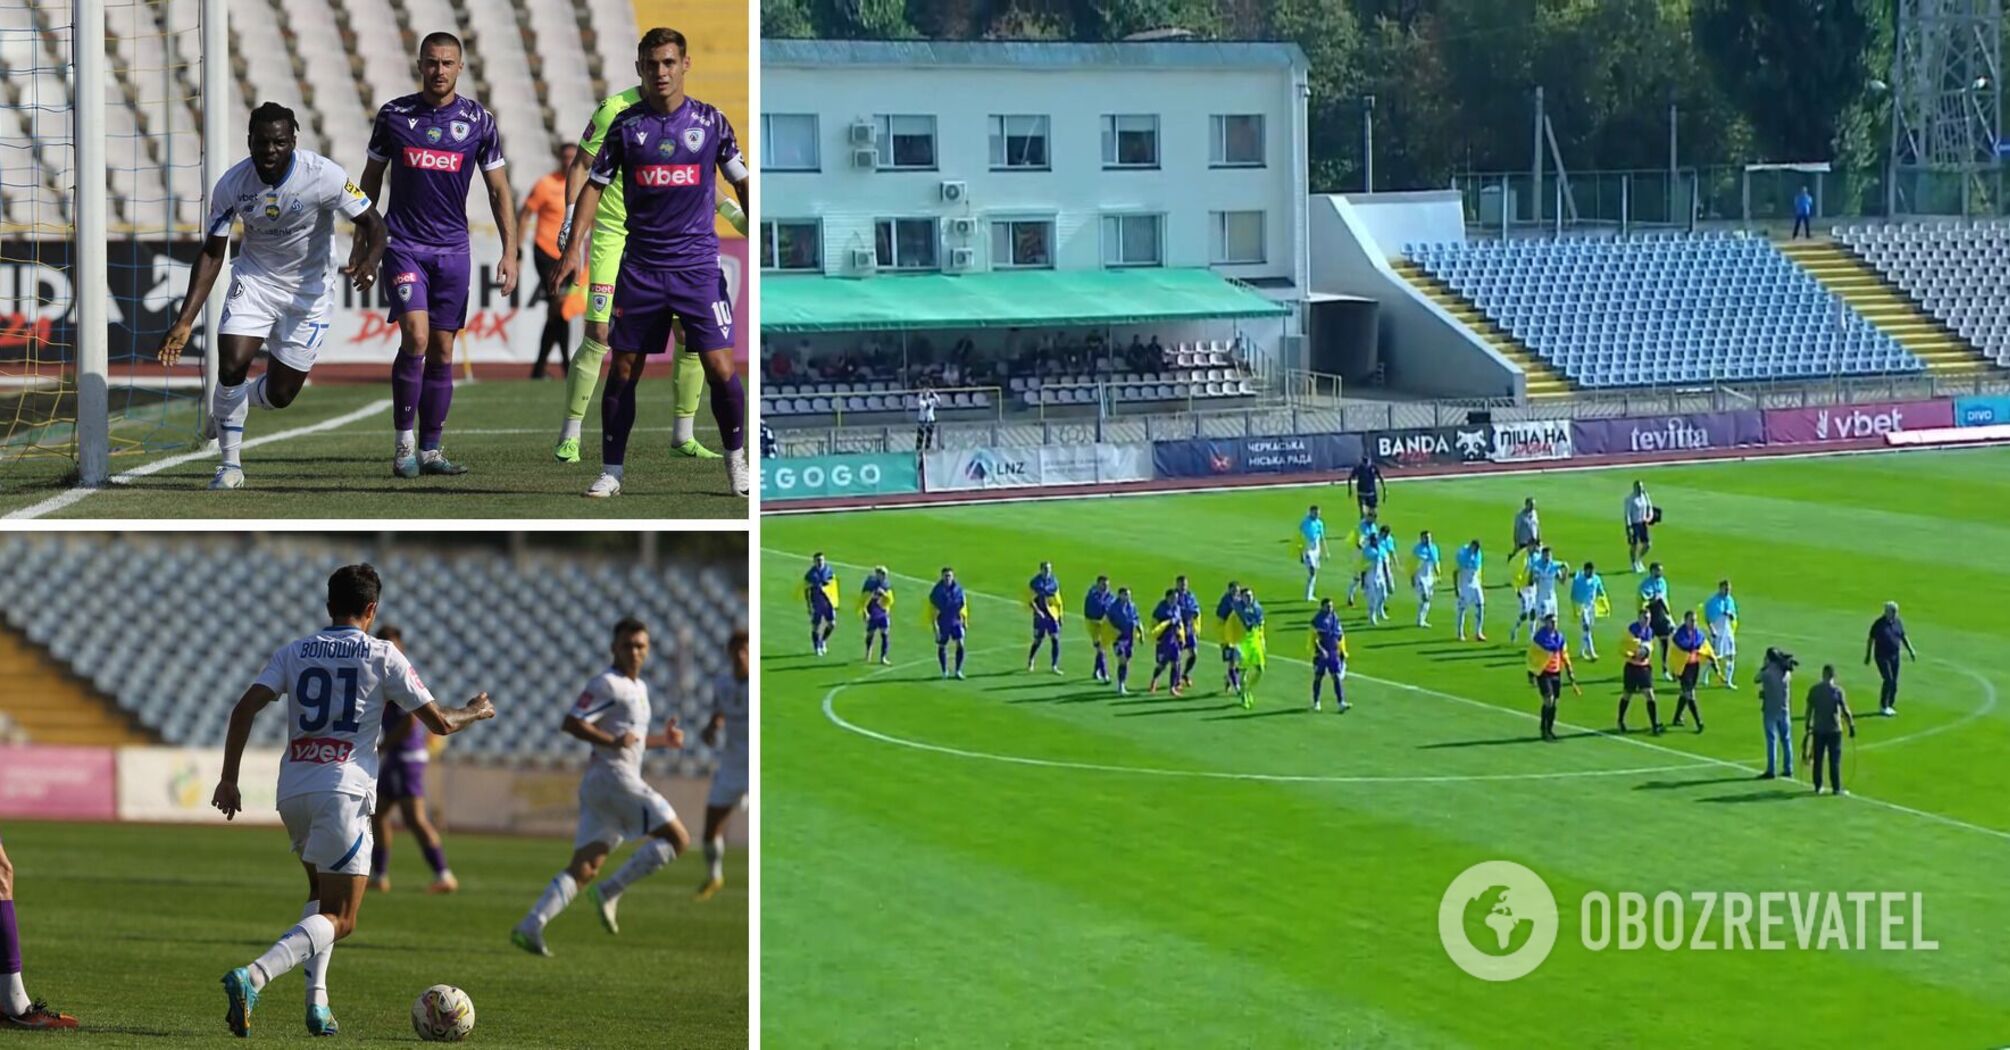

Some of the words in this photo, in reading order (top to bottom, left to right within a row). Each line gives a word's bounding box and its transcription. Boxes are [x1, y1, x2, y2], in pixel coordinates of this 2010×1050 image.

[409, 150, 459, 170] vbet
[642, 166, 695, 185] vbet
[238, 192, 258, 201] vbet
[711, 300, 733, 327] 10
[1834, 408, 1903, 438] vbet
[1631, 417, 1709, 451] tevitta
[1378, 434, 1450, 457] BANDA
[996, 462, 1026, 475] LNZ
[300, 641, 371, 659] ВОЛОШИН
[296, 666, 360, 733] 91
[295, 741, 350, 762] vbet
